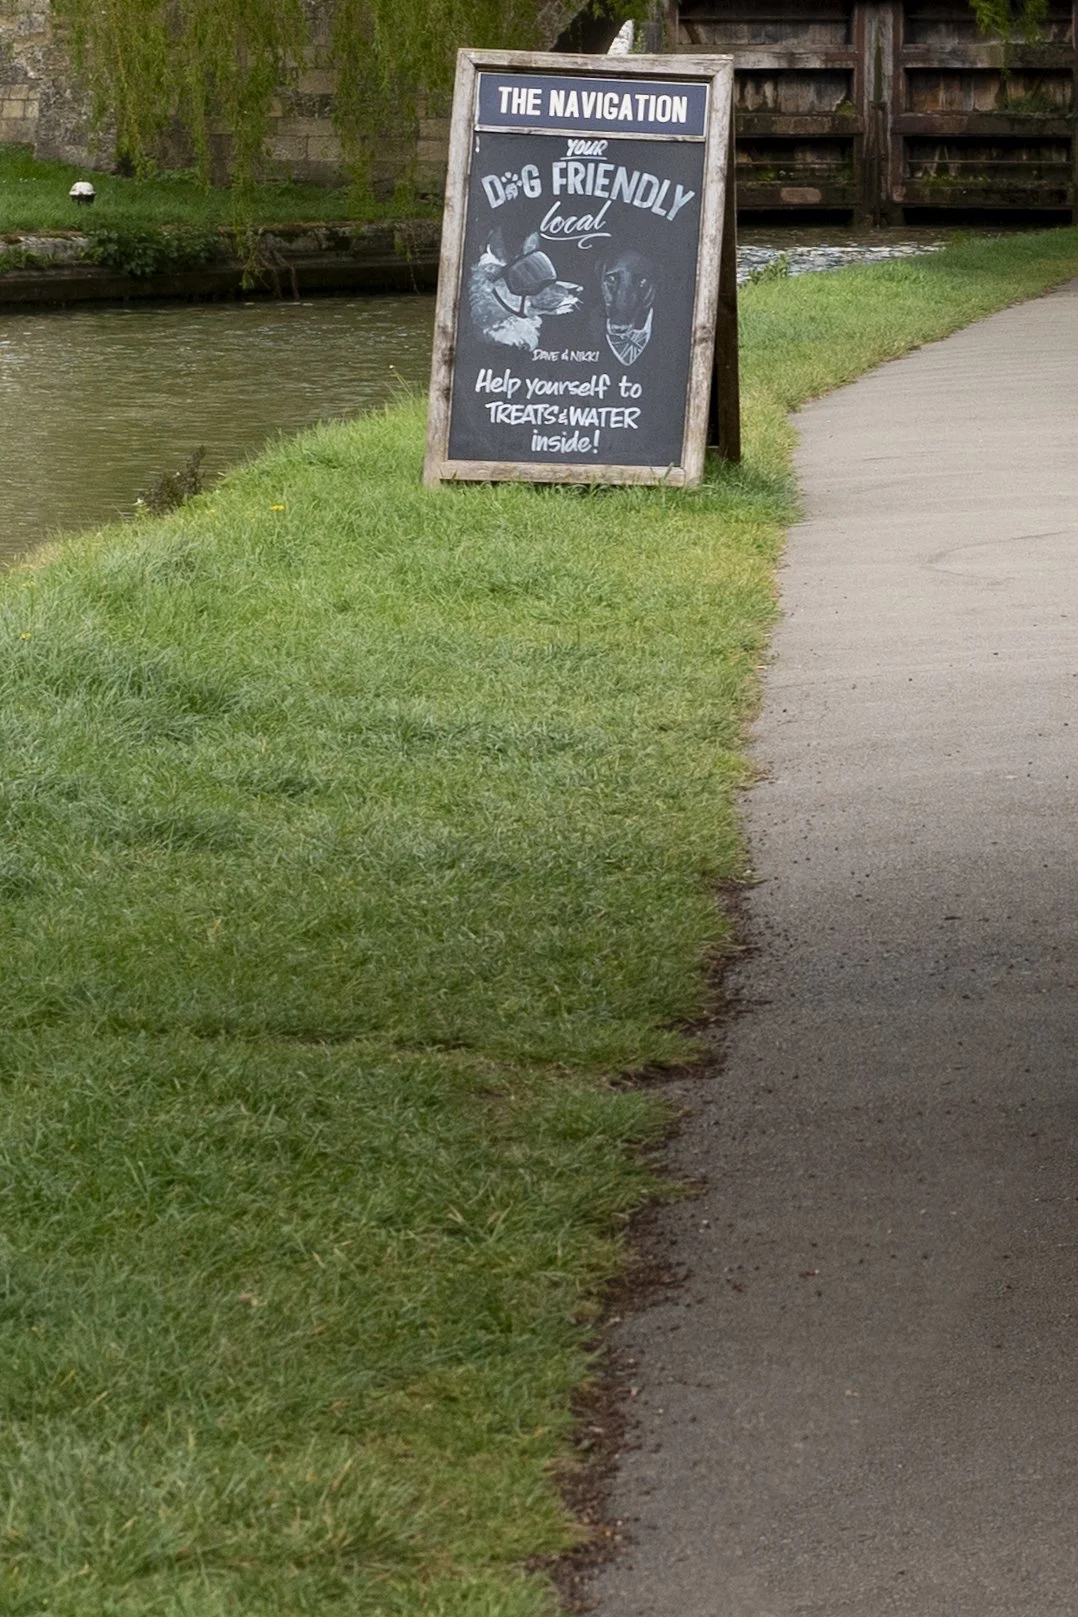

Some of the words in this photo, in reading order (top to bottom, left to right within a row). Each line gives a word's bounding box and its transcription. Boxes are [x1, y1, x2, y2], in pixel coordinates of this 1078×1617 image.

[498, 86, 542, 116] THE
[549, 89, 688, 123] NAVIGATION
[566, 139, 608, 157] YOUR
[552, 161, 696, 221] FRIENDLY
[540, 200, 612, 234] local
[532, 349, 560, 362] DAVE
[569, 350, 600, 363] NIKKI
[475, 368, 521, 399] Help
[525, 374, 611, 400] yourself
[618, 375, 643, 398] to
[531, 429, 600, 454] inside!
